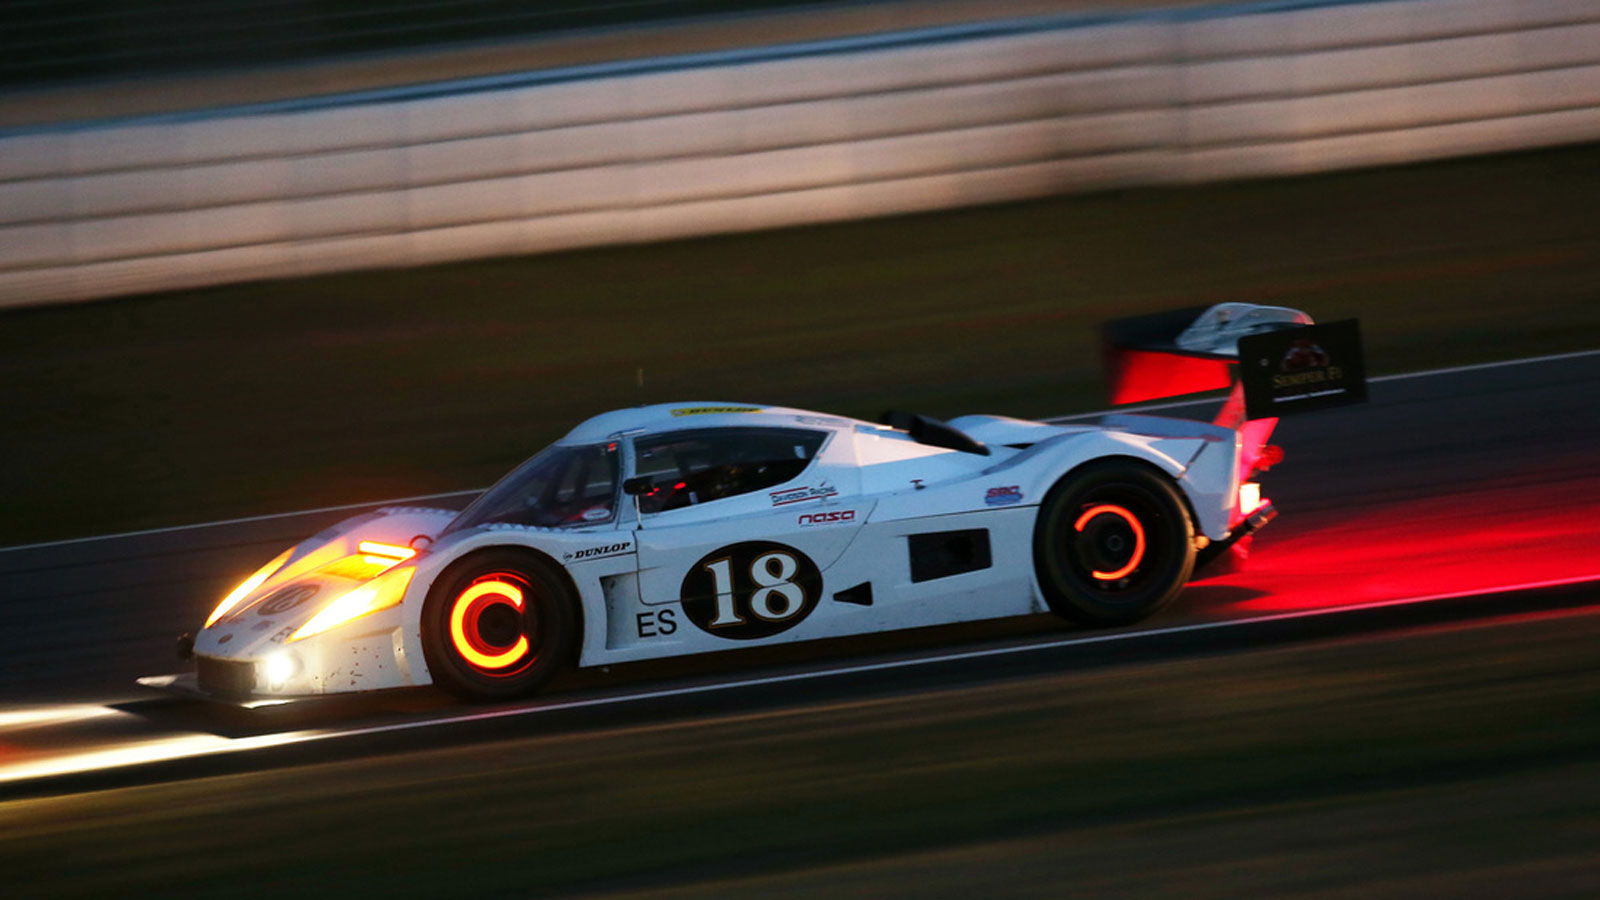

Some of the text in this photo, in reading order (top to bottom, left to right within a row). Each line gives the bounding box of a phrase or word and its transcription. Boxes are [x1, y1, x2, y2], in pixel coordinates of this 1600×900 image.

[798, 510, 856, 525] nasa
[574, 542, 631, 559] DUNLOP
[704, 551, 806, 629] 18
[636, 609, 677, 638] ES
